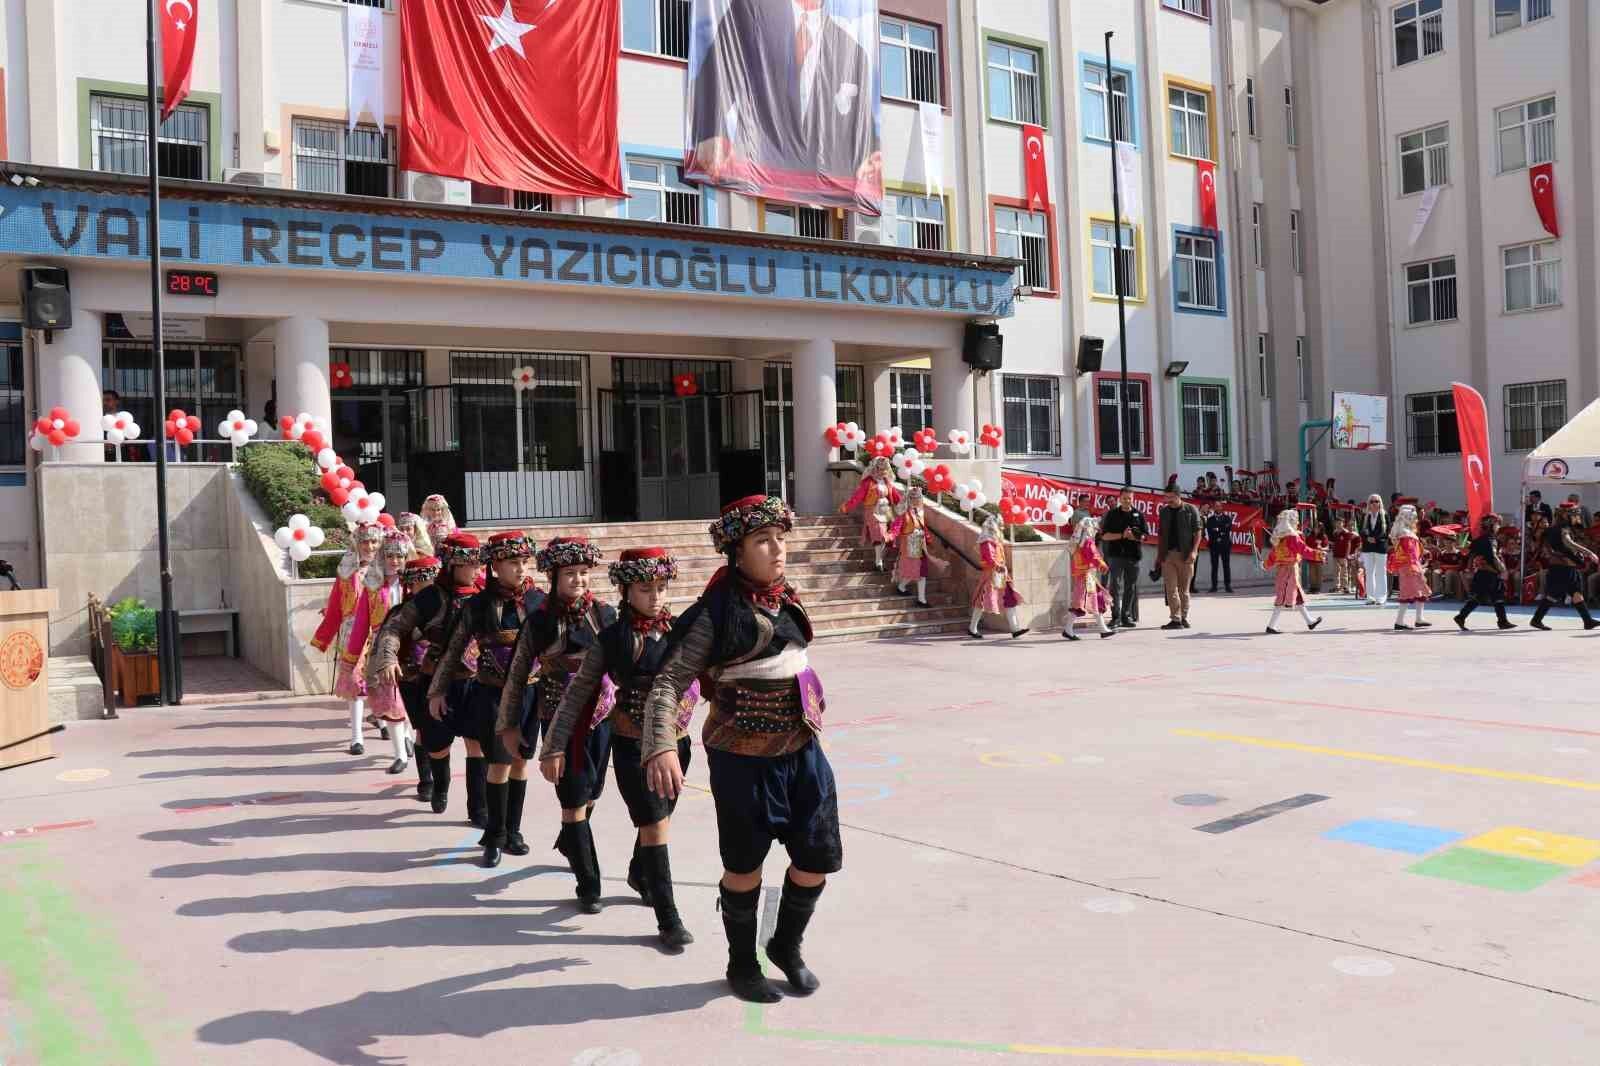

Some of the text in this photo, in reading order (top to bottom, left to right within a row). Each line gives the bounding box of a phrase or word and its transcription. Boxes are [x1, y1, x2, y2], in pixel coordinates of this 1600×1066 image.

[43, 202, 993, 310] VALİ RECEP YAZICIOĞLU İLKOKULU
[171, 275, 190, 291] 28
